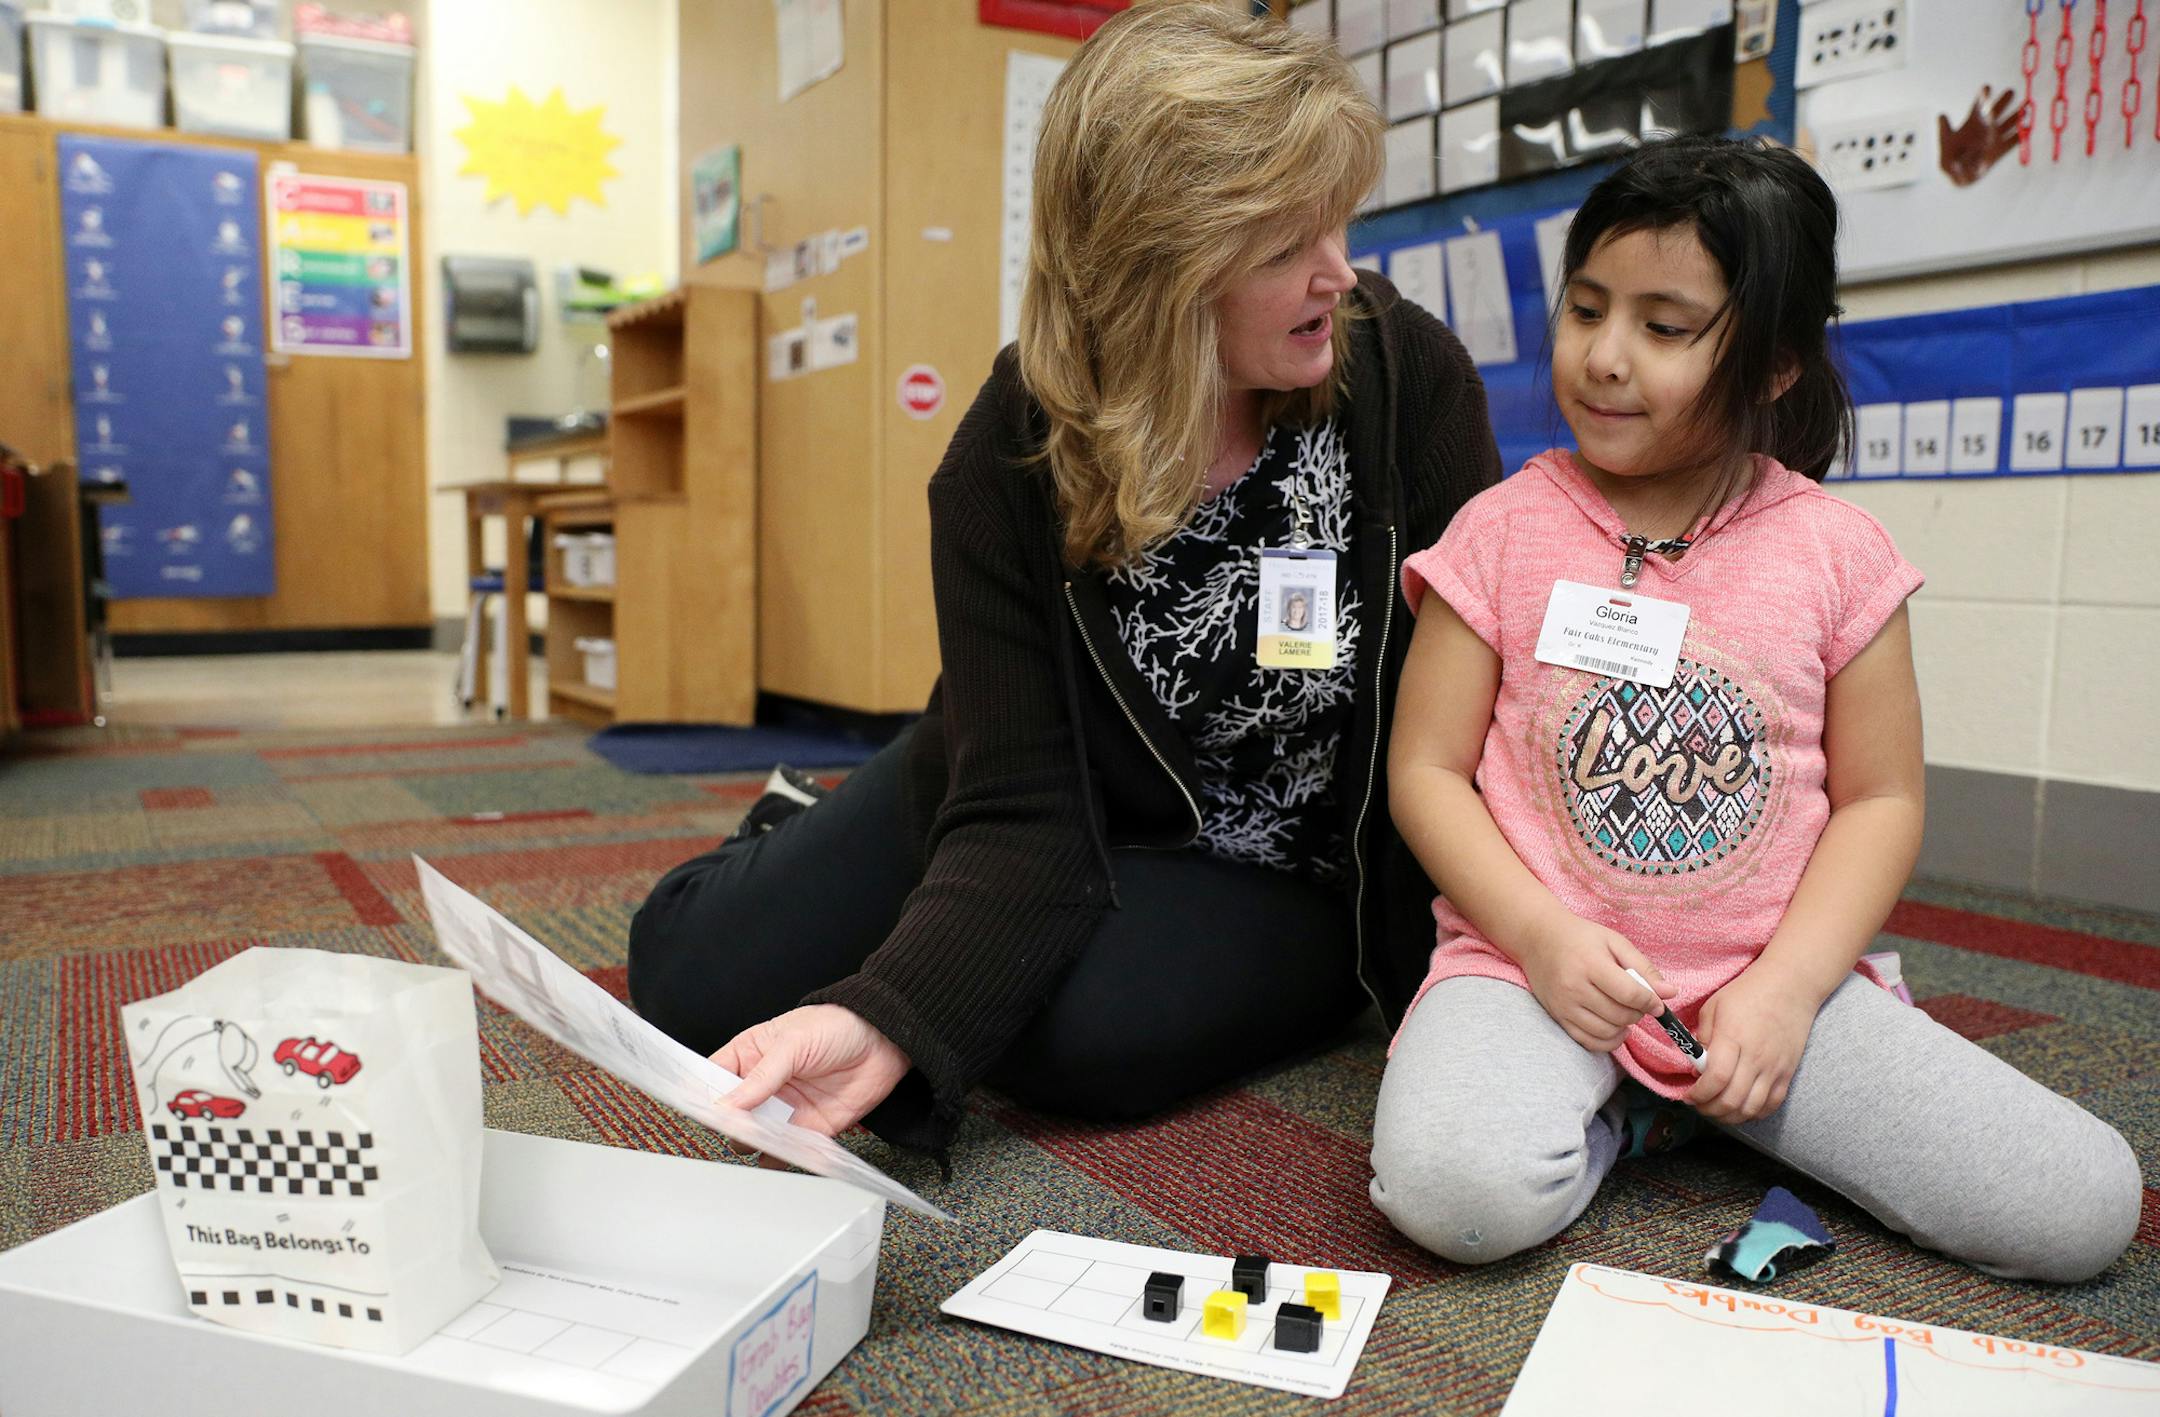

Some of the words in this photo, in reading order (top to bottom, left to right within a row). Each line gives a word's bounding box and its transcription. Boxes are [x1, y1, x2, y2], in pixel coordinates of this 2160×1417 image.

[1867, 439, 1890, 460] 13
[1915, 437, 1937, 457] 14
[1961, 434, 1986, 457] 15
[2025, 431, 2051, 453] 16
[2080, 425, 2108, 449] 17
[1318, 590, 1329, 629] 2017-18
[1595, 605, 1638, 625] Gloria
[1279, 641, 1312, 649] VALERIE
[1279, 648, 1312, 656] LAMERE
[1563, 626, 1582, 638] Fair
[1583, 631, 1605, 643] Oaks
[1607, 636, 1660, 656] Elementary
[1575, 708, 1754, 804] Love
[186, 1224, 222, 1245] This
[225, 1228, 261, 1251] Bag
[264, 1231, 343, 1254] Belongs
[347, 1237, 371, 1255] To
[1663, 1282, 1818, 1325] Doubles
[1854, 1313, 1934, 1345] Bag
[739, 1320, 779, 1384] Grab
[1972, 1334, 2085, 1368] Grab
